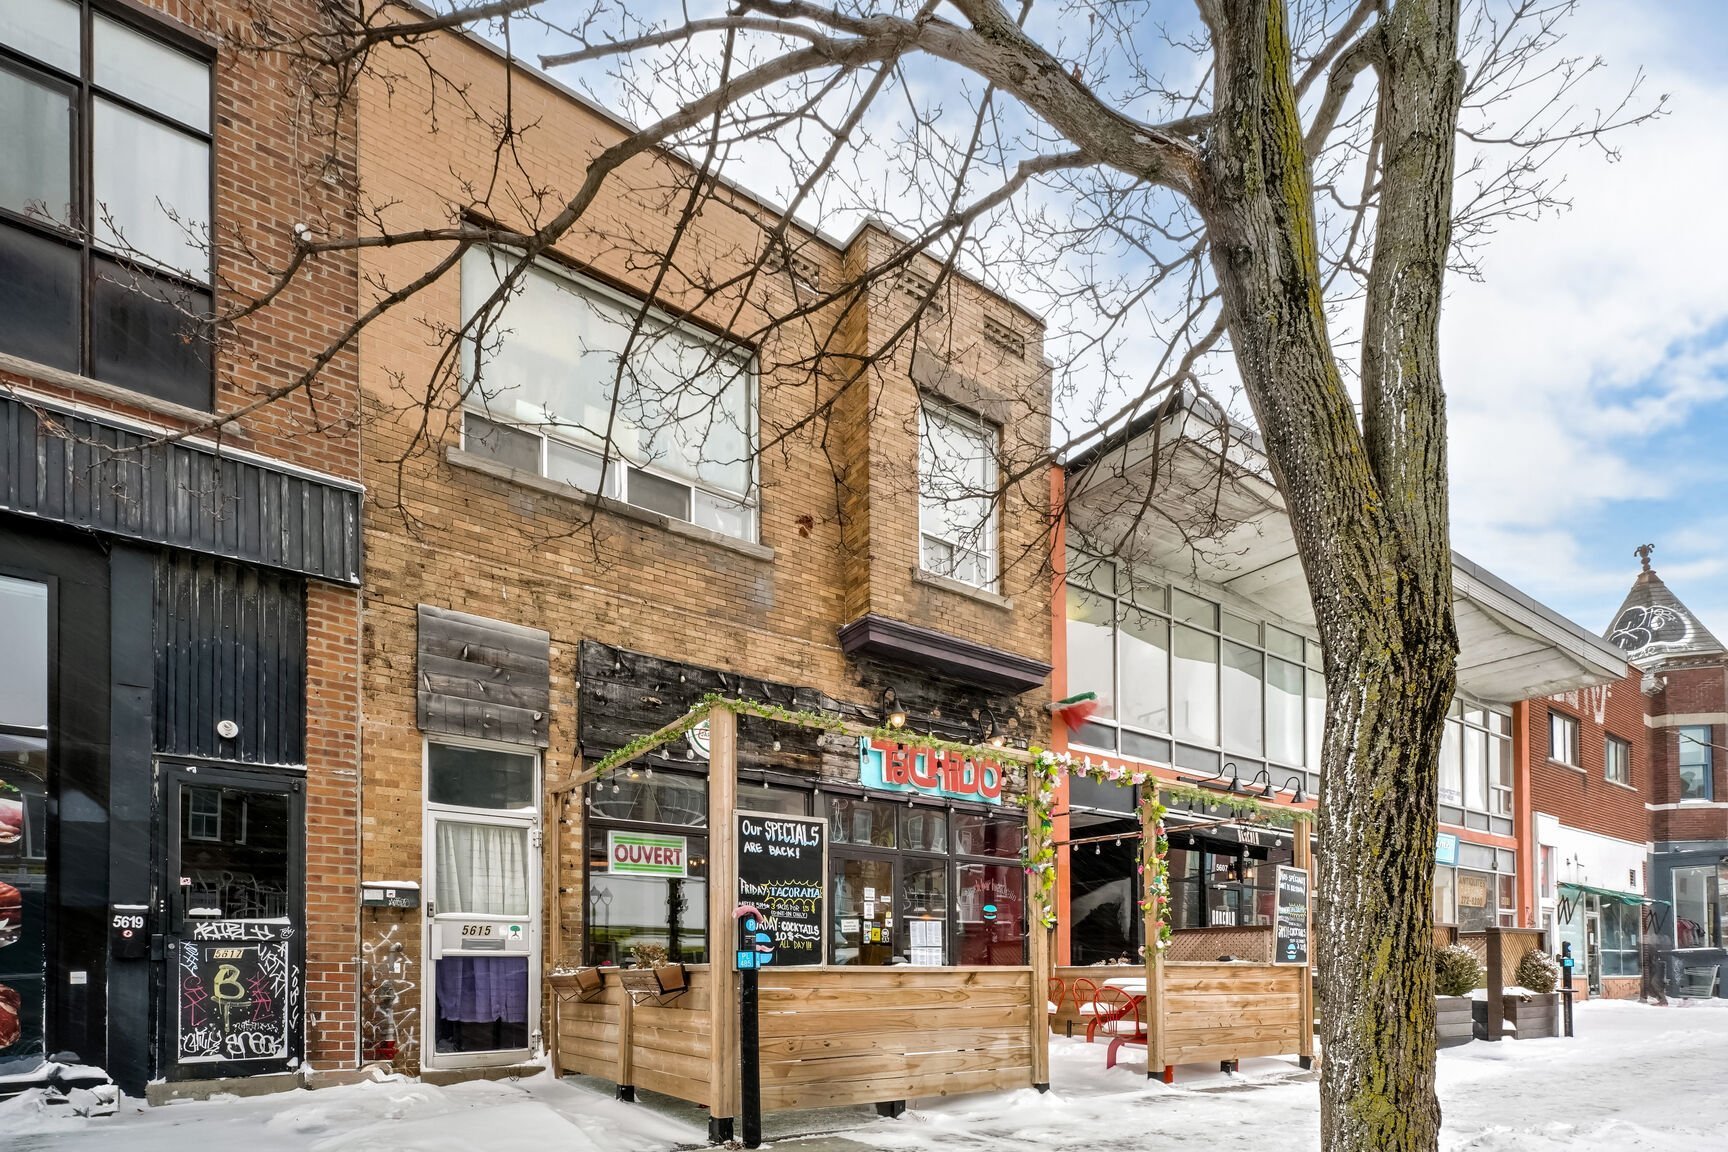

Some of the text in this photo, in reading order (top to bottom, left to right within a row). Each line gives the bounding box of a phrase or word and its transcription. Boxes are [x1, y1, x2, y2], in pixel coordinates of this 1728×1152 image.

[742, 819, 820, 847] Our SPECIALS
[614, 844, 683, 866] OUVERT
[743, 841, 800, 859] ARE BACK!
[769, 886, 820, 898] TACORAMA
[112, 915, 144, 929] 5619
[781, 921, 820, 936] COCKTAILS
[462, 925, 492, 936] 5615
[779, 940, 790, 949] ALL
[213, 949, 244, 959] 5617
